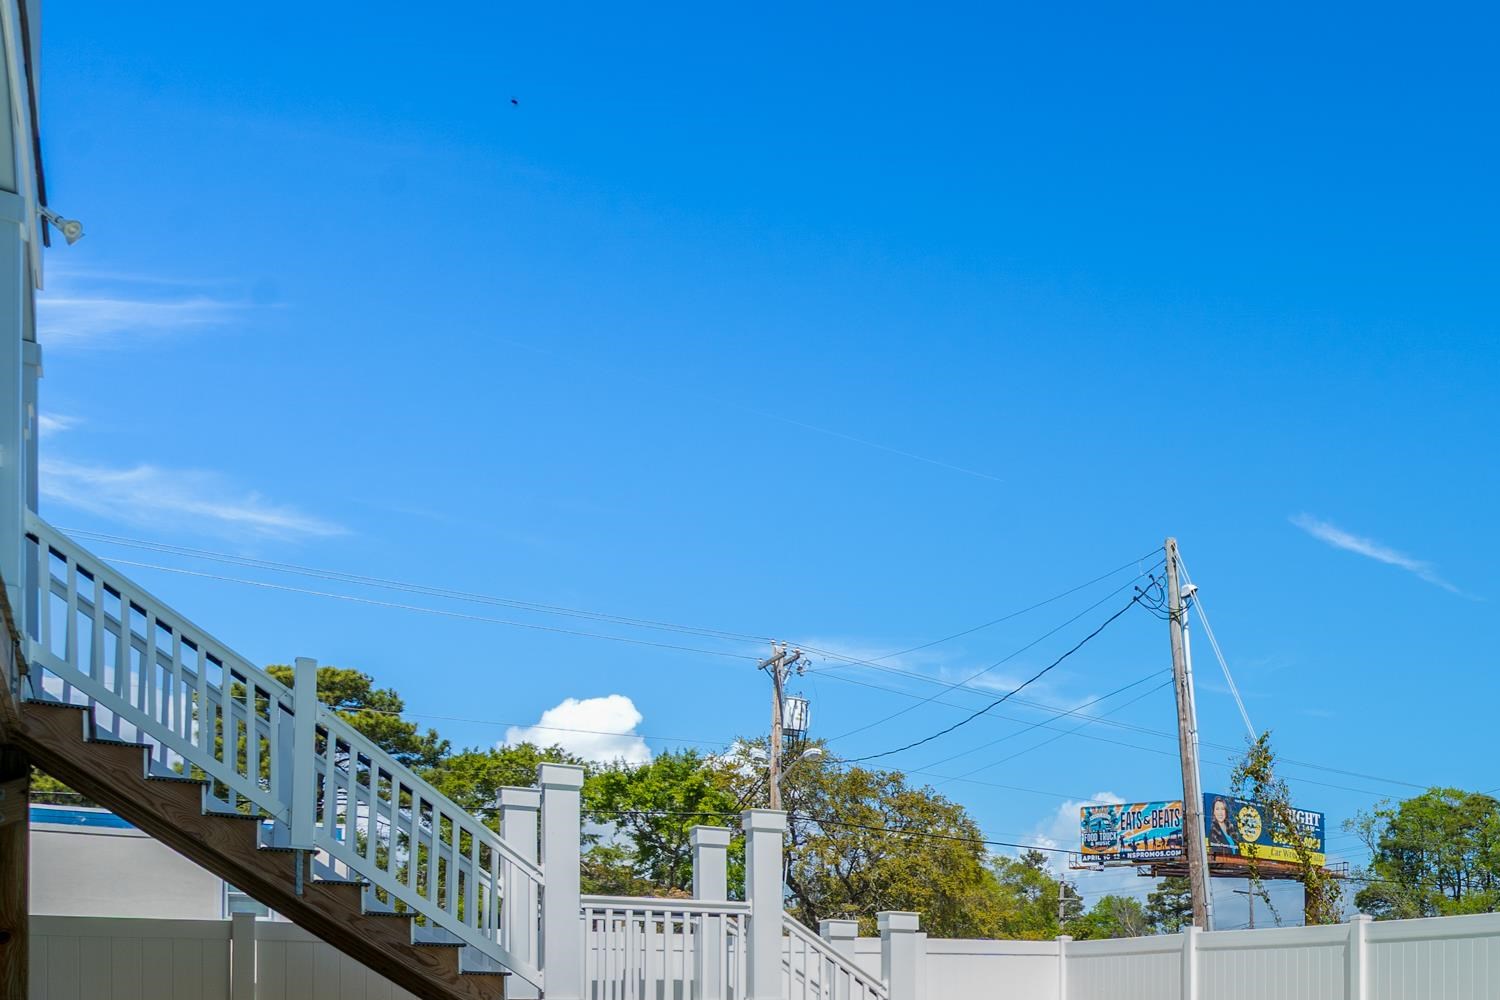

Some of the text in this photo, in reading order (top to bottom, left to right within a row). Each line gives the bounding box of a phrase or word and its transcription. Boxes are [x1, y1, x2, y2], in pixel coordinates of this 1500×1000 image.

[1121, 811, 1142, 830] EATS
[1144, 816, 1150, 825] &
[1152, 809, 1180, 828] BEATS
[1084, 831, 1118, 842] FOOD TRUCK
[1082, 854, 1101, 862] APRIL
